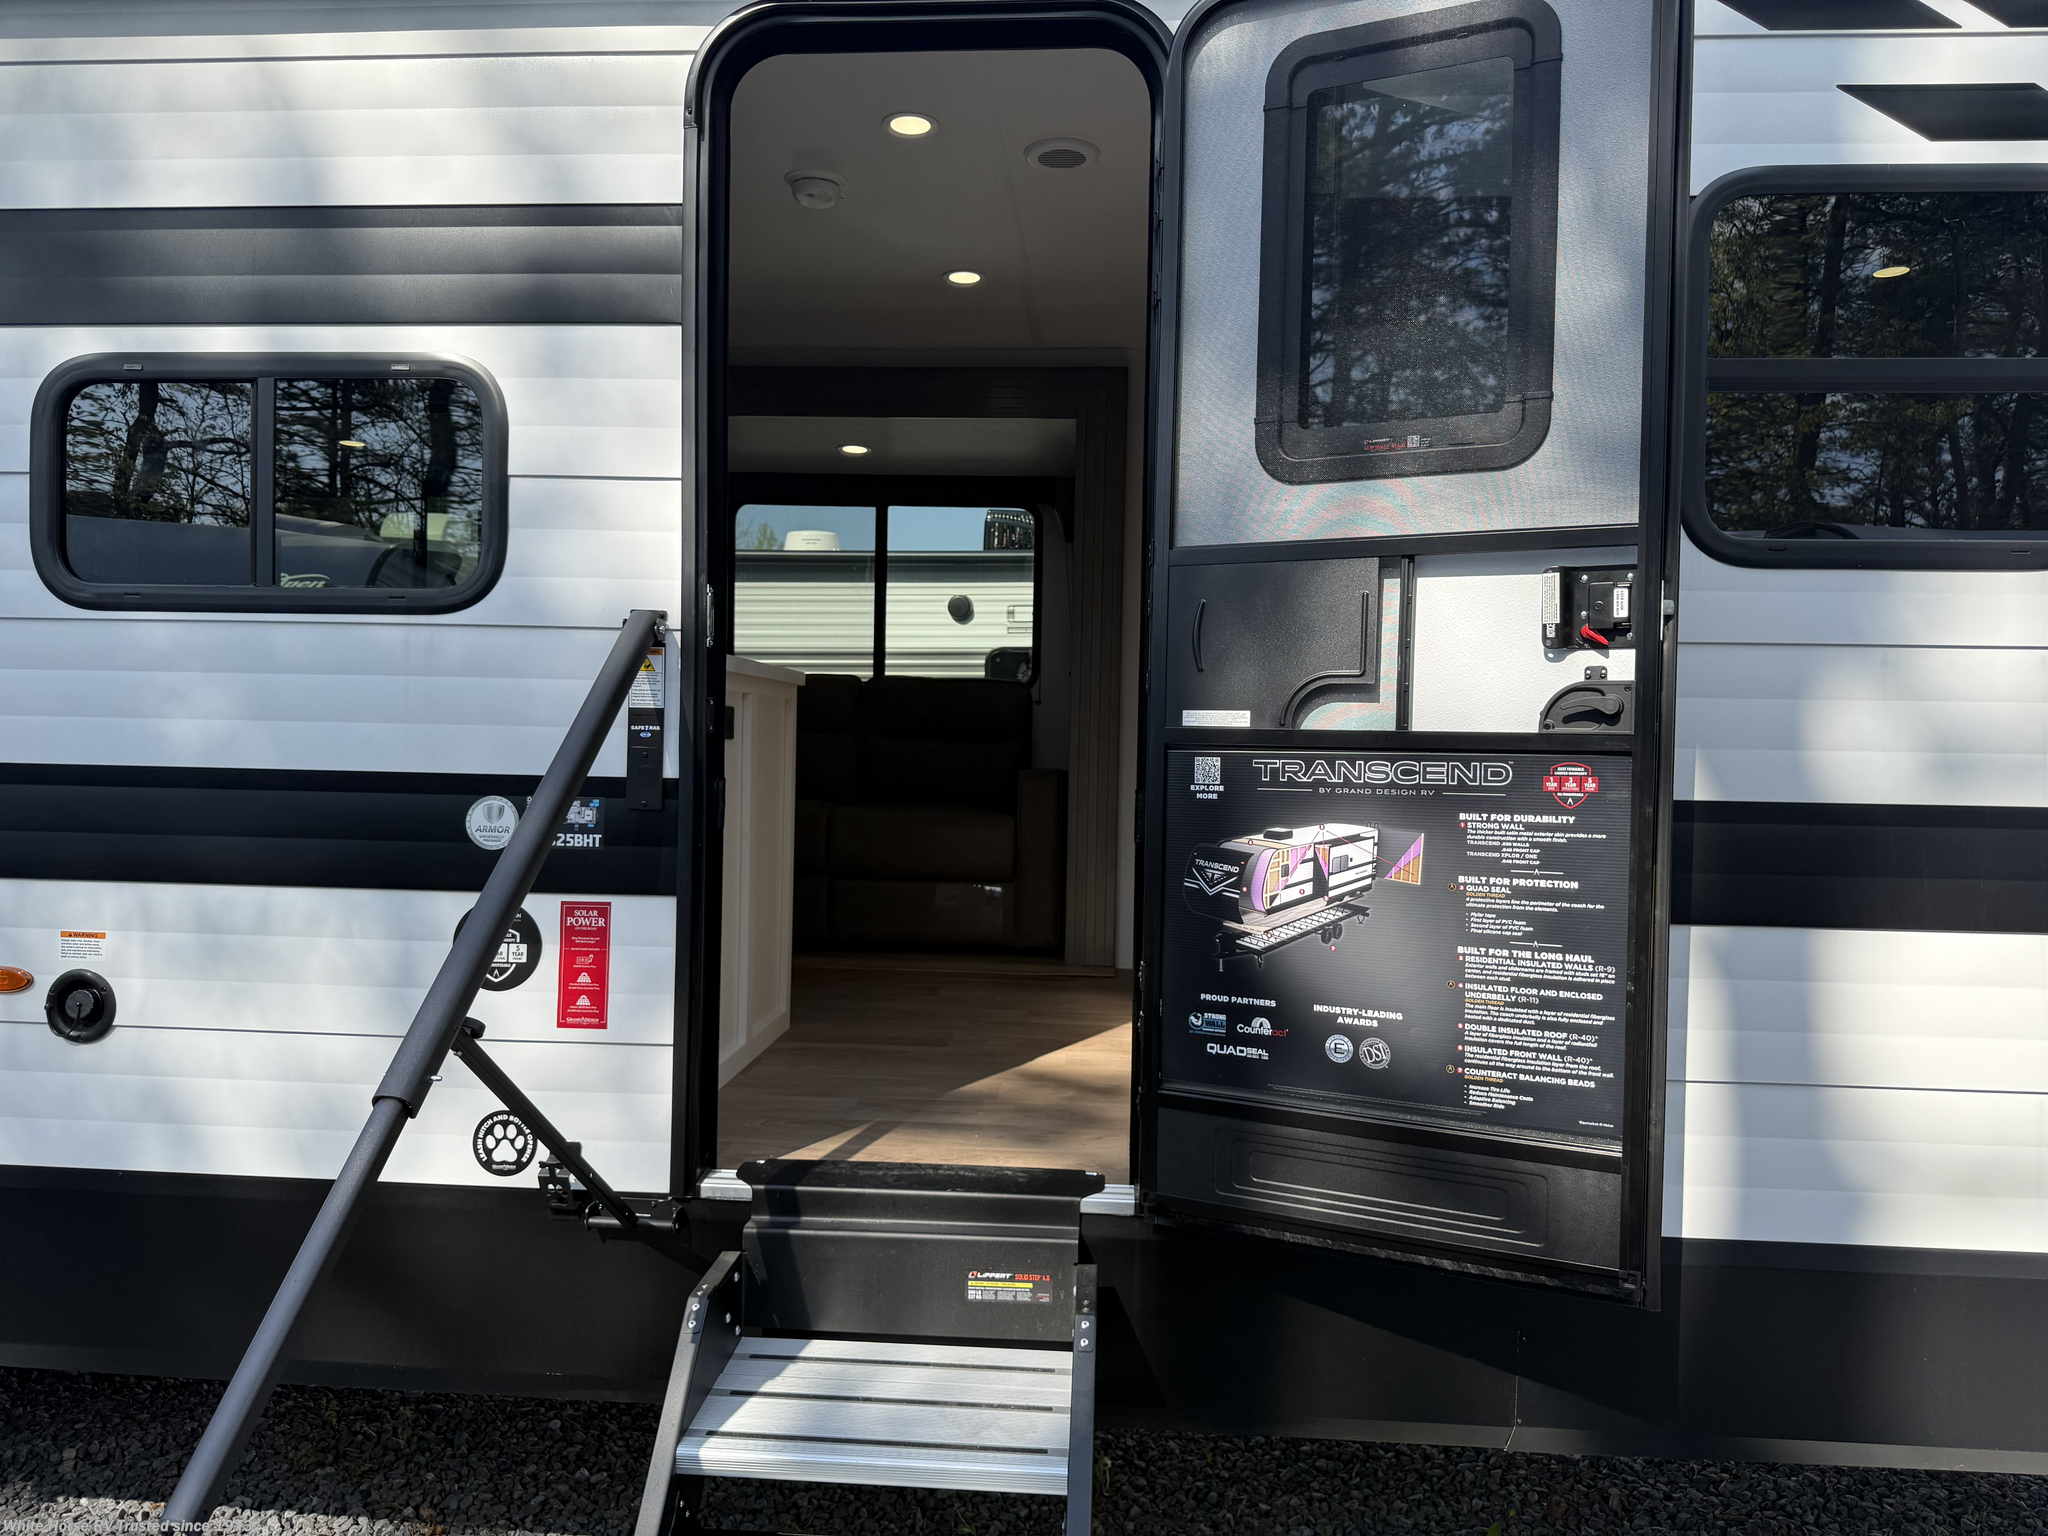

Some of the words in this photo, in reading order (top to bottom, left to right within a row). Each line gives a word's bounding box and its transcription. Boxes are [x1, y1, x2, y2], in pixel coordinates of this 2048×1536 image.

[1252, 759, 1513, 786] TRANSCEND
[1514, 814, 1576, 824] DURABILITY
[475, 825, 510, 834] ARMOR
[1195, 859, 1240, 873] TRANSCEND
[1490, 877, 1510, 885] FOR
[1513, 878, 1579, 889] PROTECTION
[566, 917, 606, 927] POWER
[1457, 946, 1486, 955] BUILT
[1489, 948, 1509, 957] FOR
[1512, 950, 1532, 959] THE
[1534, 952, 1563, 961] LONG
[1566, 954, 1595, 963] HAUL
[1465, 955, 1516, 966] RESIDENTIAL
[1518, 959, 1563, 969] INSULATED
[1564, 963, 1593, 971] WALLS
[1465, 983, 1509, 992] INSULATED
[1510, 987, 1538, 995] FLOOR
[1539, 989, 1558, 997] AND
[1559, 991, 1603, 1000] ENCLOSED
[1465, 991, 1516, 1001] UNDERBELLY
[1518, 996, 1539, 1004] (R-11)
[1200, 993, 1229, 1003] PROUD
[1231, 996, 1276, 1007] PARTNERS
[1204, 1013, 1226, 1021] STRONG
[1313, 1004, 1403, 1021] INDUSTRY-LEADING
[1205, 1020, 1225, 1028] WALL
[1337, 1016, 1378, 1028] AWARDS
[1237, 1023, 1288, 1037] Counteract
[1465, 1023, 1497, 1033] DOUBLE
[1498, 1026, 1543, 1037] INSULATED
[1544, 1031, 1568, 1039] ROOF
[1334, 1043, 1344, 1055] E
[1363, 1043, 1386, 1063] DSI
[1465, 1045, 1508, 1056] INSULATED
[1510, 1050, 1537, 1059] FRONT
[1539, 1053, 1563, 1062] WALL
[1464, 1068, 1518, 1080] COUNTERACT
[1519, 1073, 1566, 1085] BALANCING
[1568, 1079, 1595, 1088] BEADS
[1488, 1092, 1518, 1100] Maintenance
[1492, 1097, 1516, 1106] Balancing
[1469, 1100, 1492, 1108] Smoother
[493, 1114, 508, 1122] AND
[478, 1119, 493, 1138] HITCH
[476, 1138, 487, 1162] LEASH
[521, 1134, 533, 1163] OPENER
[977, 1272, 1010, 1280] LIPPERT
